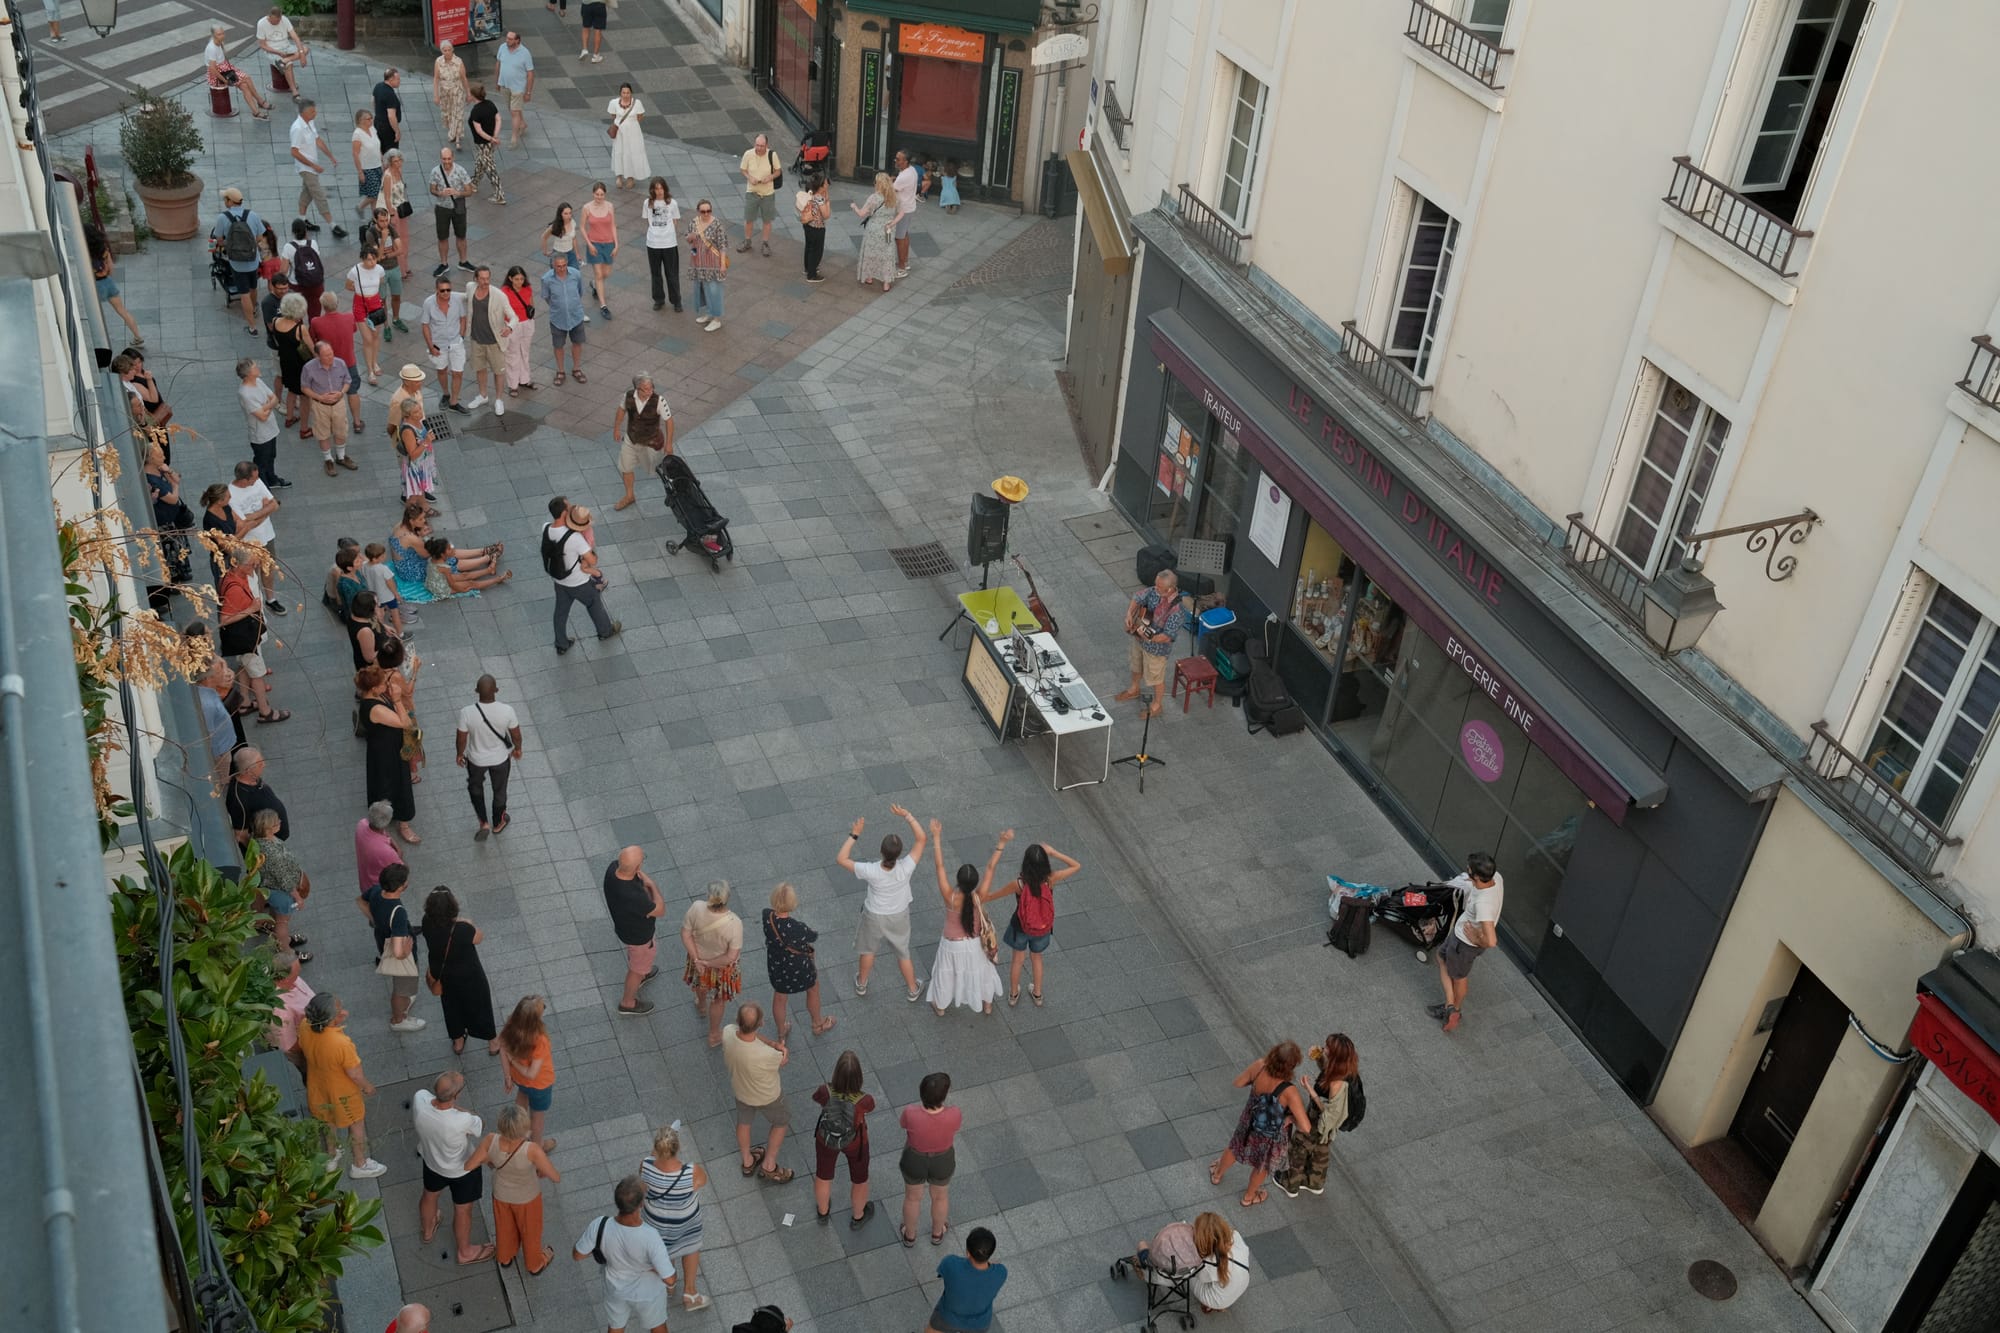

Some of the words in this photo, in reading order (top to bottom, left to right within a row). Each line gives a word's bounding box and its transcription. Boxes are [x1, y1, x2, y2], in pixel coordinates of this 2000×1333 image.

[907, 28, 923, 41] Le
[926, 30, 976, 48] Fromager
[918, 43, 931, 54] de
[1203, 388, 1241, 438] TRAITEUR
[1288, 383, 1312, 425] LE
[1321, 415, 1393, 497] FESTIN
[1402, 490, 1503, 605] D'ITALIE
[1446, 636, 1500, 699] EPICERIE
[1504, 694, 1533, 733] FINE
[1927, 1032, 1997, 1106] Sylvie
